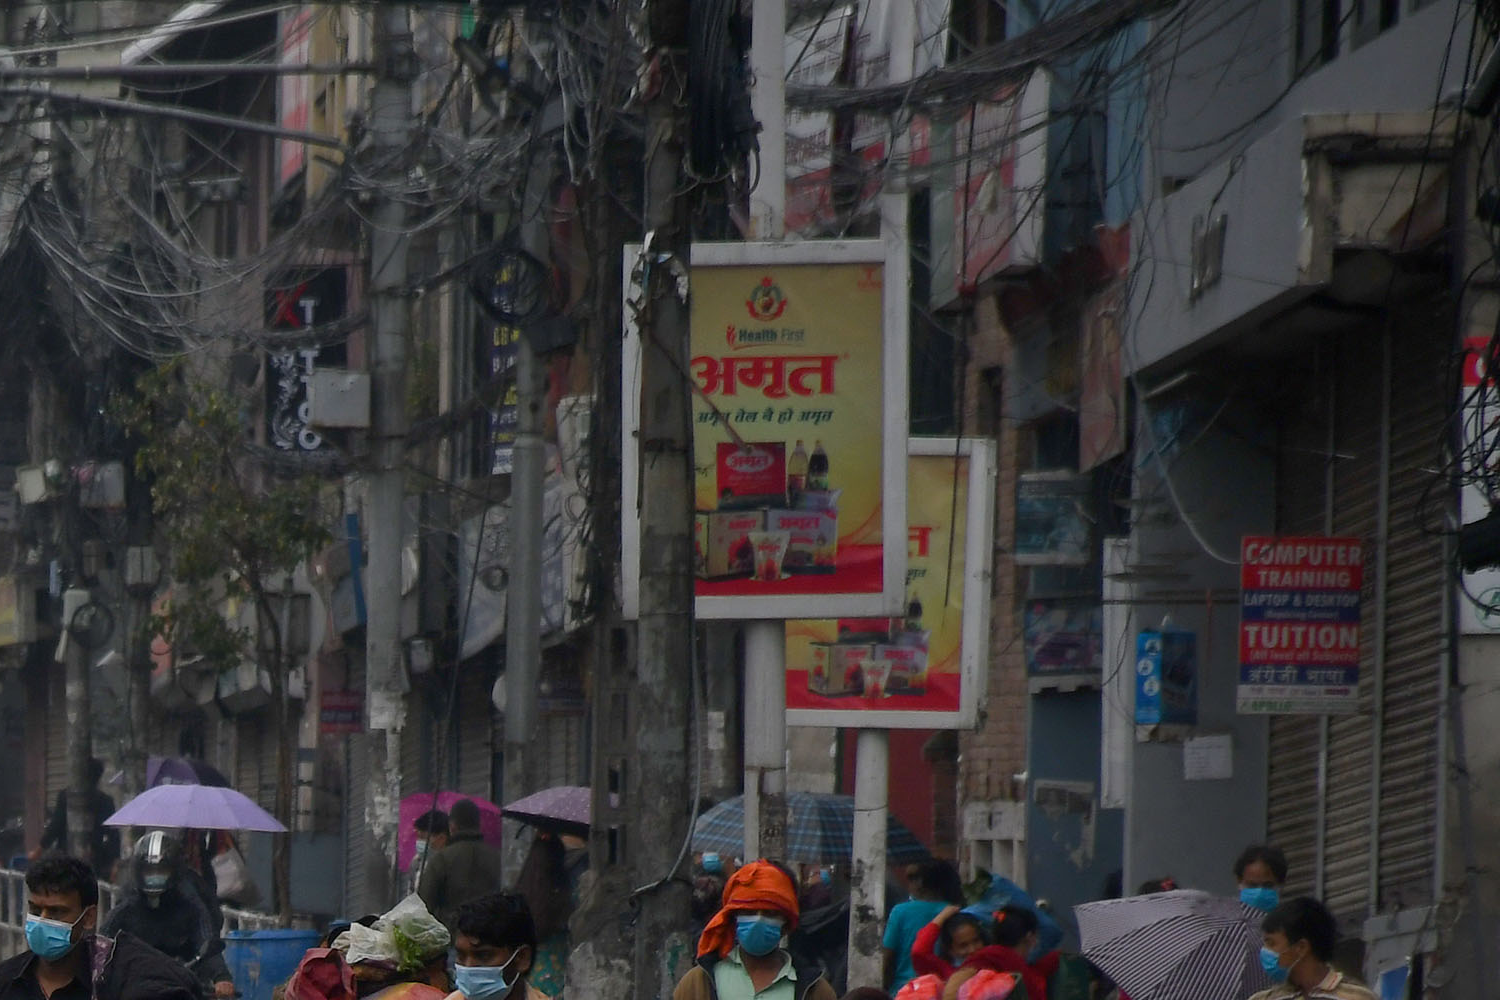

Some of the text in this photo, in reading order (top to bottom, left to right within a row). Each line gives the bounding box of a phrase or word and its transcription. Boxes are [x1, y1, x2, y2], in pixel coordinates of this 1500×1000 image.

[738, 328, 805, 343] Health First
[690, 355, 839, 399] अमृत
[798, 409, 834, 426] अमृत
[1245, 543, 1362, 566] COMPUTER
[1258, 570, 1351, 588] TRAINING
[1243, 592, 1291, 607] LAPTOP
[1243, 625, 1357, 649] TUITION
